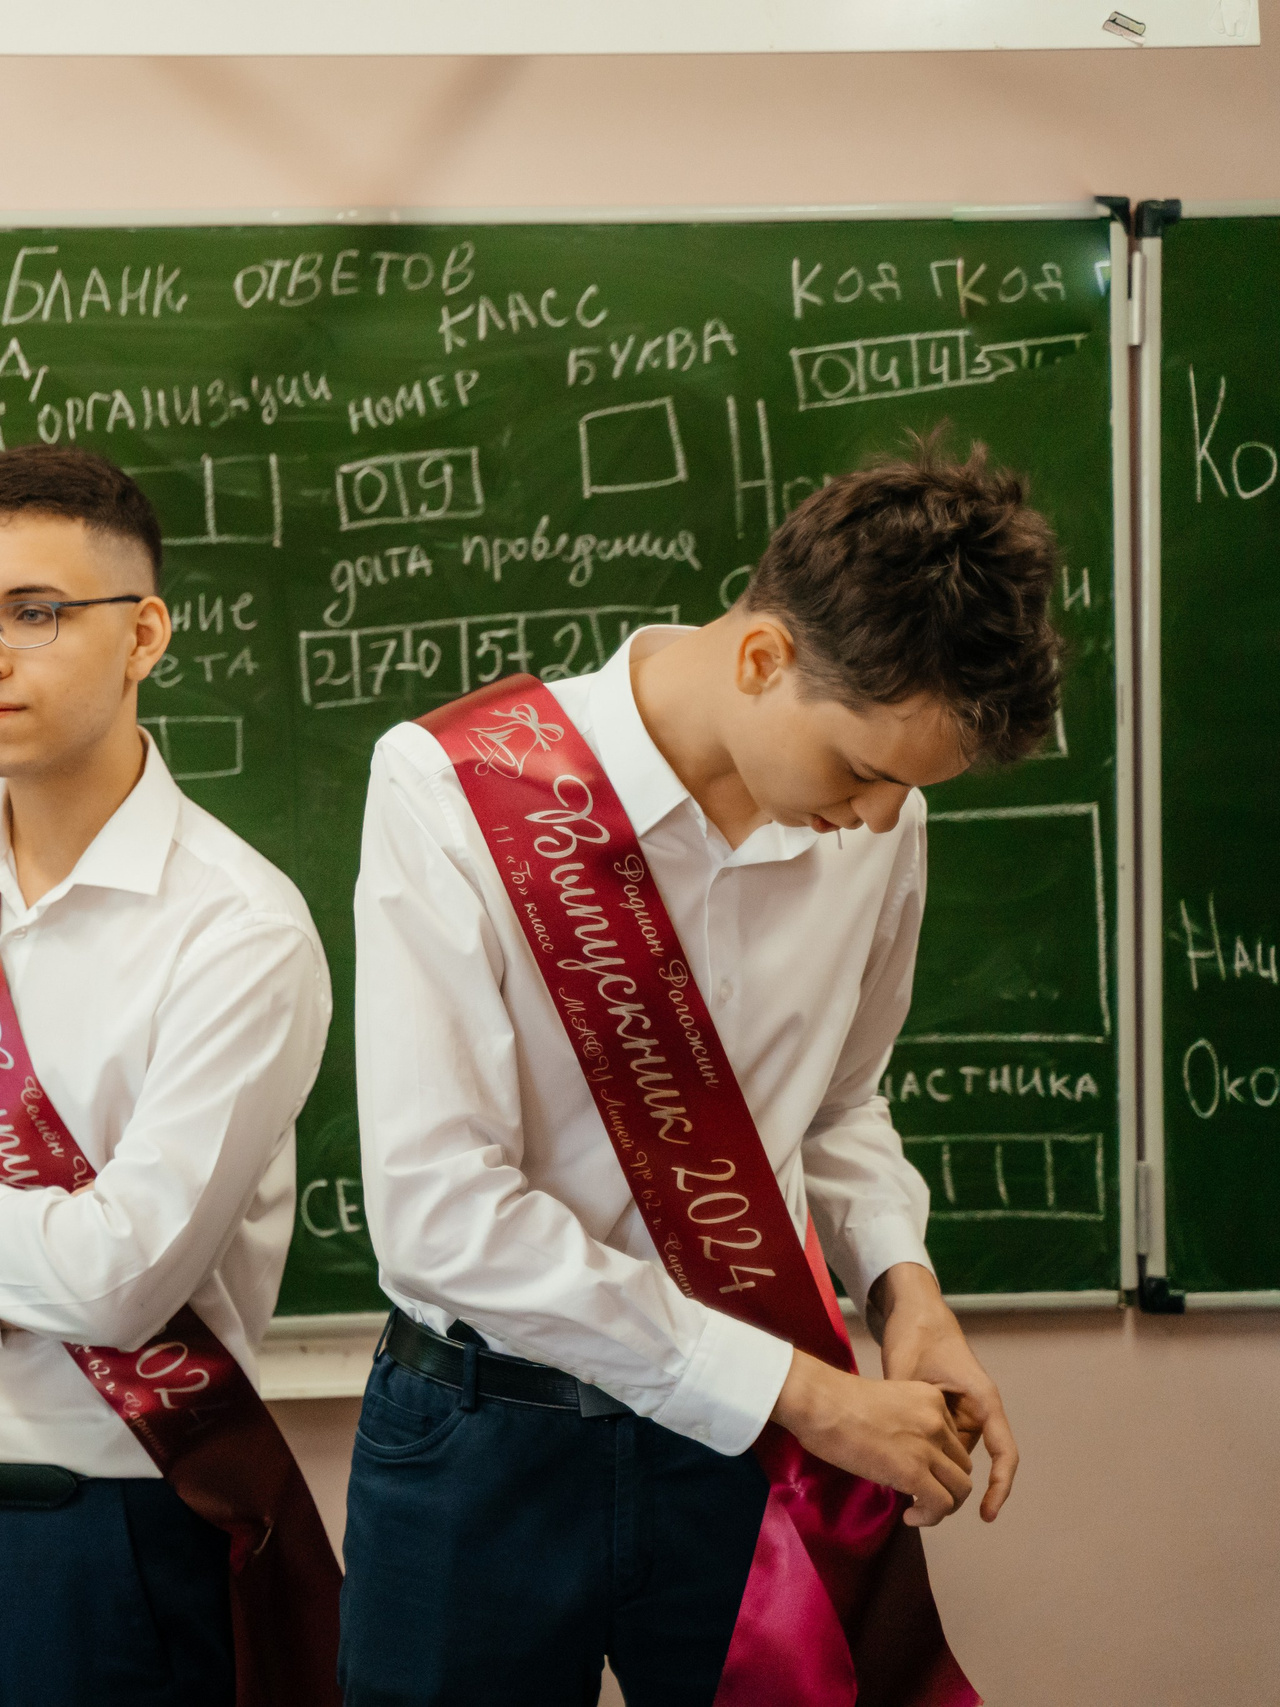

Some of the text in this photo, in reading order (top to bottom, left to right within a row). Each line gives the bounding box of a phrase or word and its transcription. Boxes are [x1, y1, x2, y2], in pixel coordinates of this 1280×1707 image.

[233, 240, 476, 308] ОТВЕТОВ
[438, 284, 609, 354] КЛАСС
[567, 317, 739, 386] БУКВА
[523, 773, 777, 1295] Выпускник 2024
